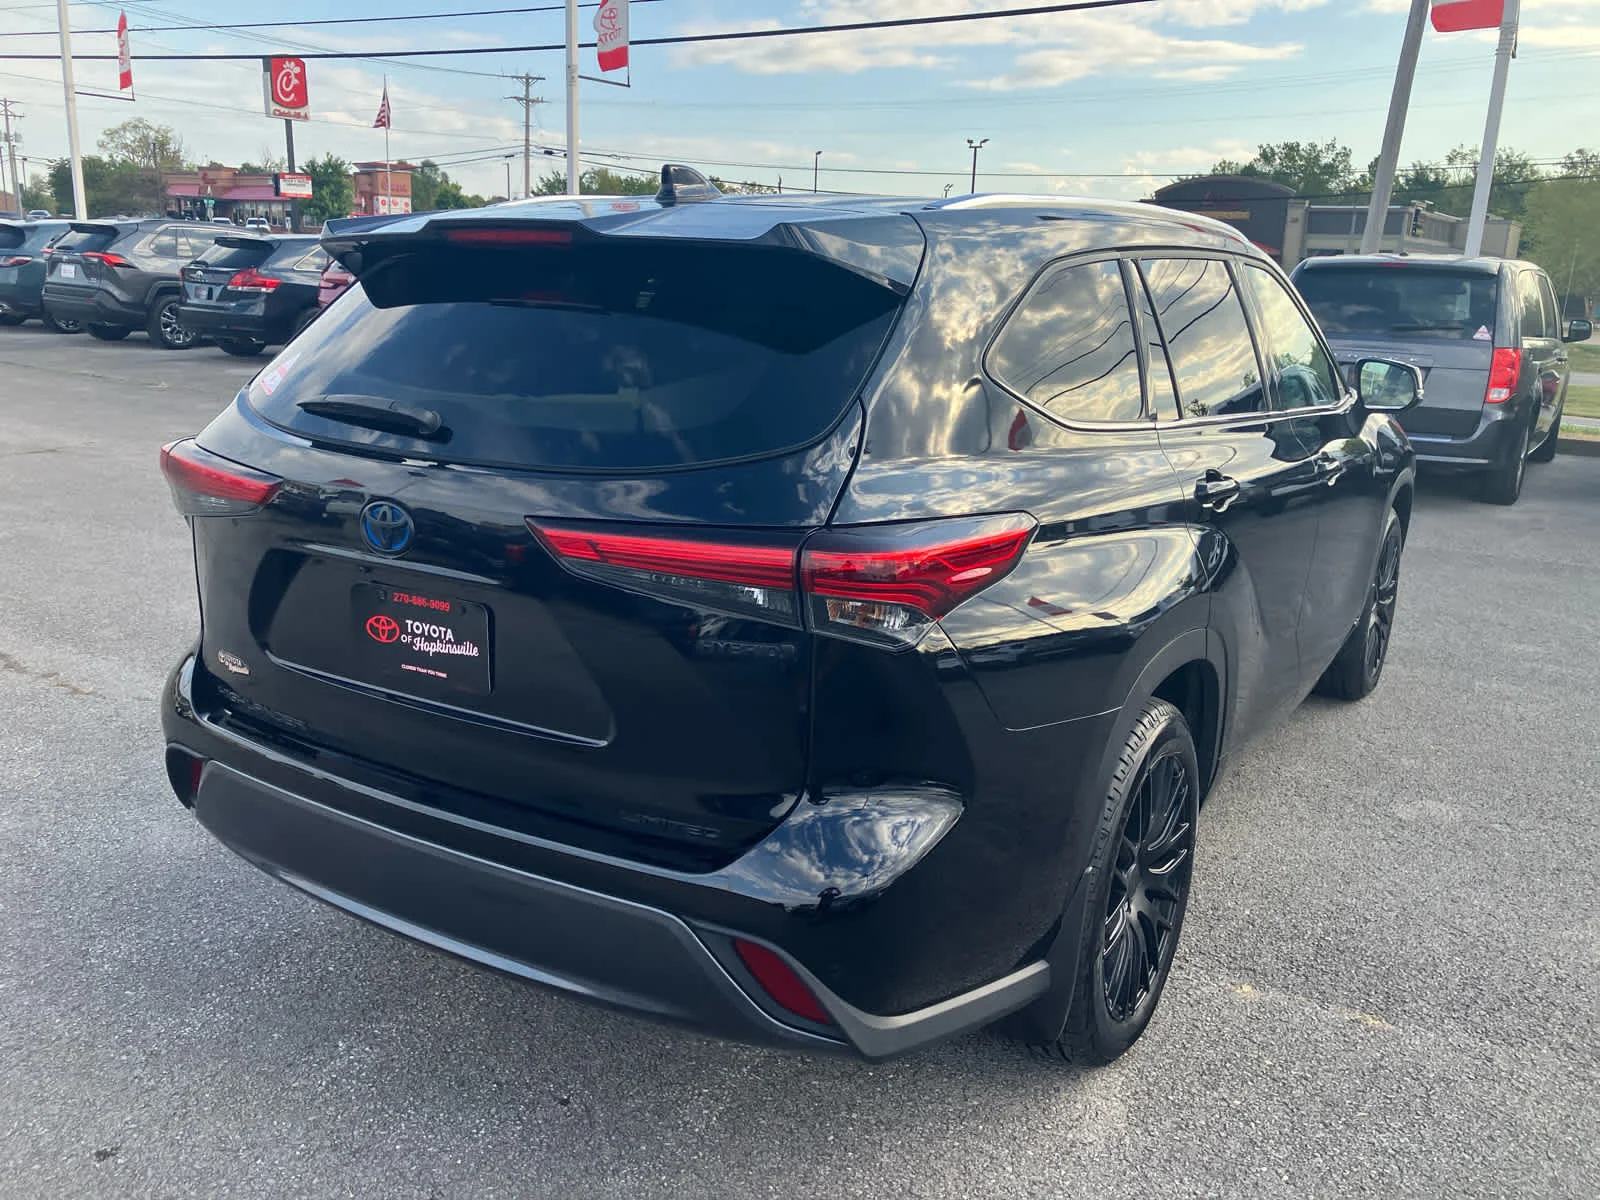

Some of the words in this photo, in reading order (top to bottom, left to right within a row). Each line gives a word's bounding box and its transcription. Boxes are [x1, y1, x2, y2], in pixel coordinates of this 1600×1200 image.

[405, 620, 454, 642] TOYOTA
[401, 634, 413, 643] OF
[413, 637, 479, 657] Hopkinsville
